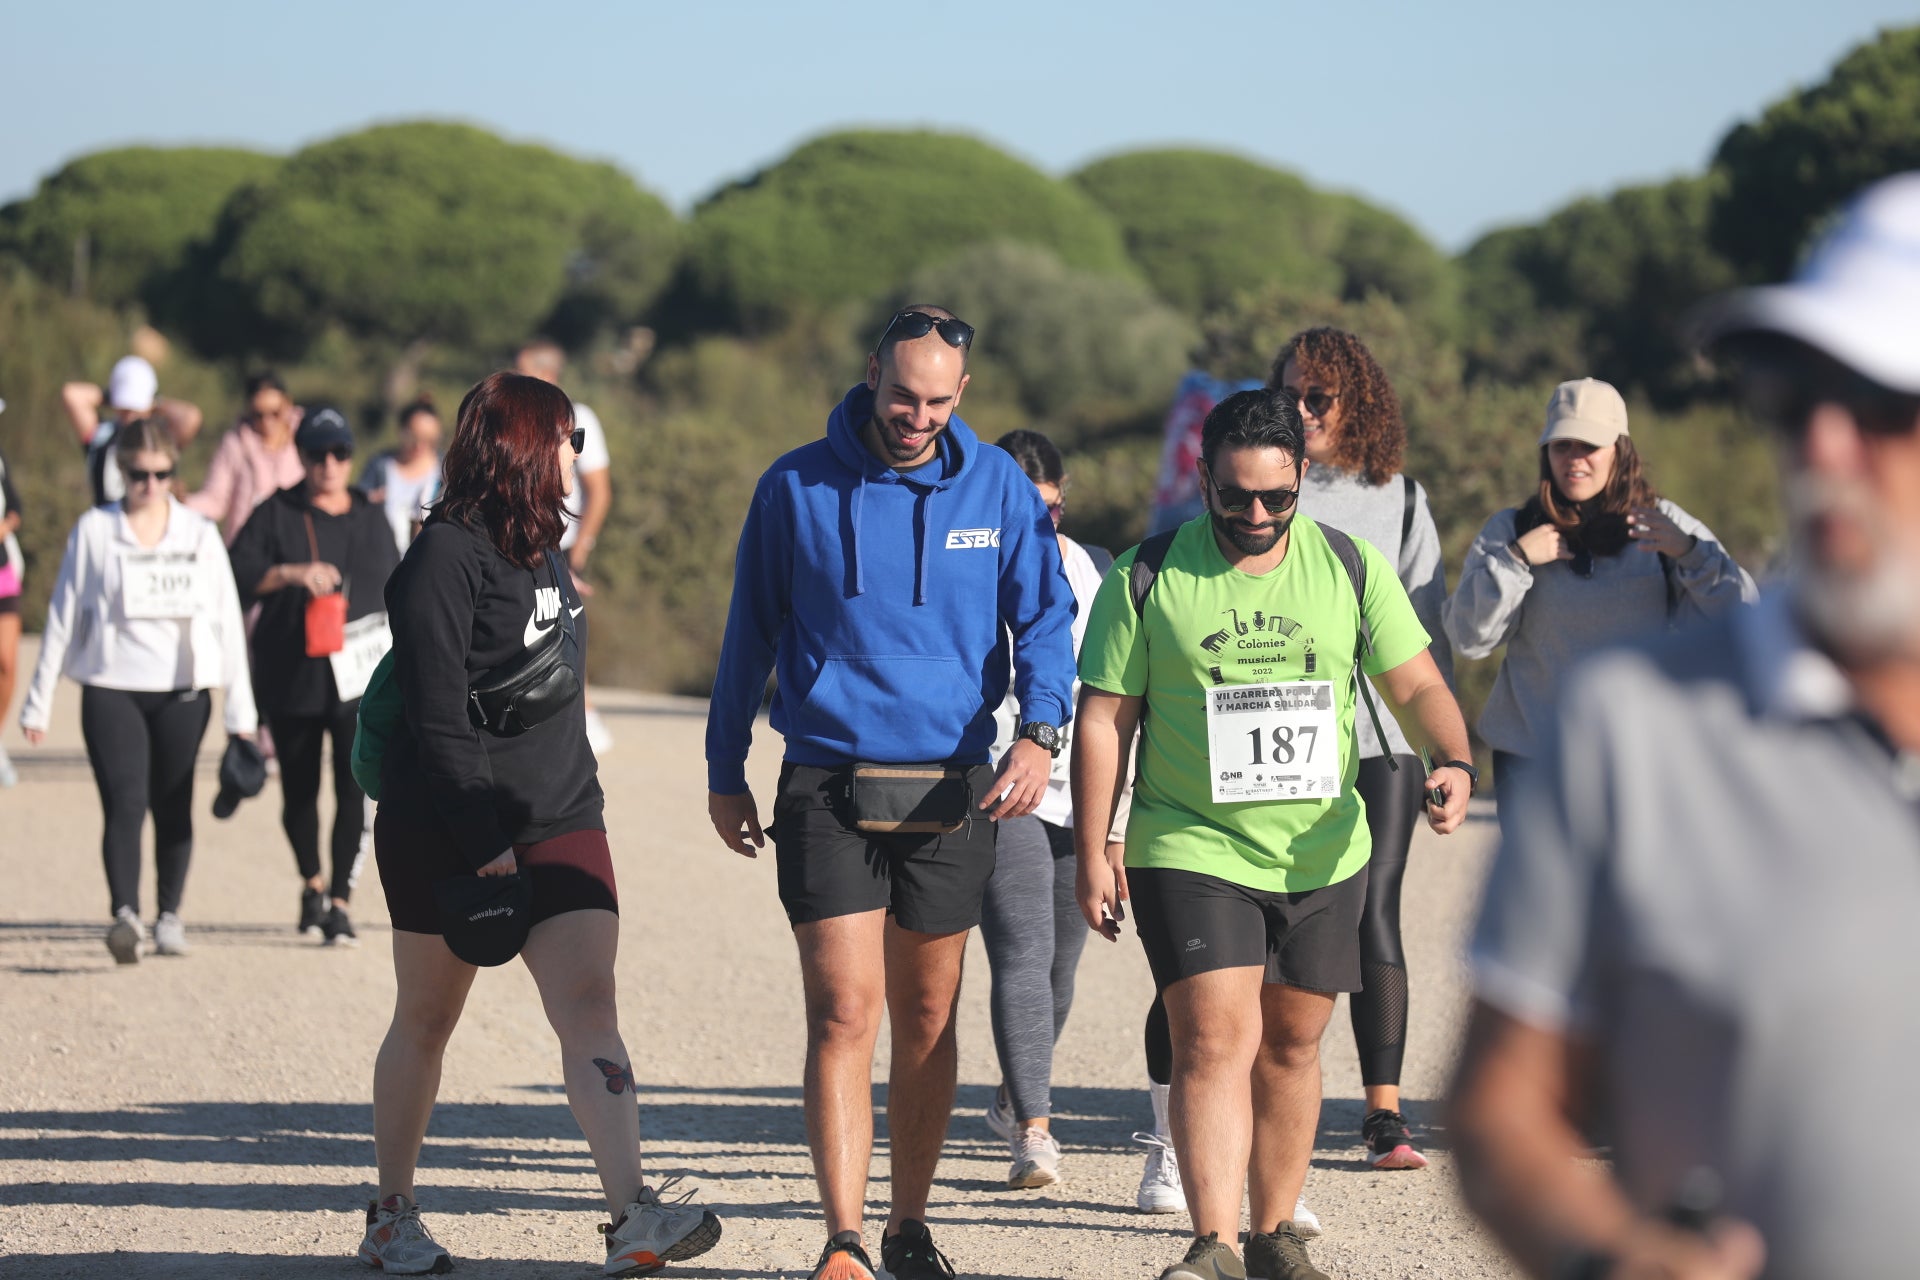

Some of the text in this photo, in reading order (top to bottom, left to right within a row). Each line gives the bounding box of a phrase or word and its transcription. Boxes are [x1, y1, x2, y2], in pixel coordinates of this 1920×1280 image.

[146, 571, 192, 596] 209
[534, 586, 570, 622] NIK
[1237, 638, 1286, 649] Colònies
[1237, 653, 1287, 665] musicals
[1252, 667, 1273, 675] 2022
[1216, 688, 1324, 700] VII CARRERA POPUL
[1216, 700, 1320, 712] Y MARCHA SOLIDAR
[1246, 726, 1319, 766] 187
[1230, 771, 1243, 779] NB
